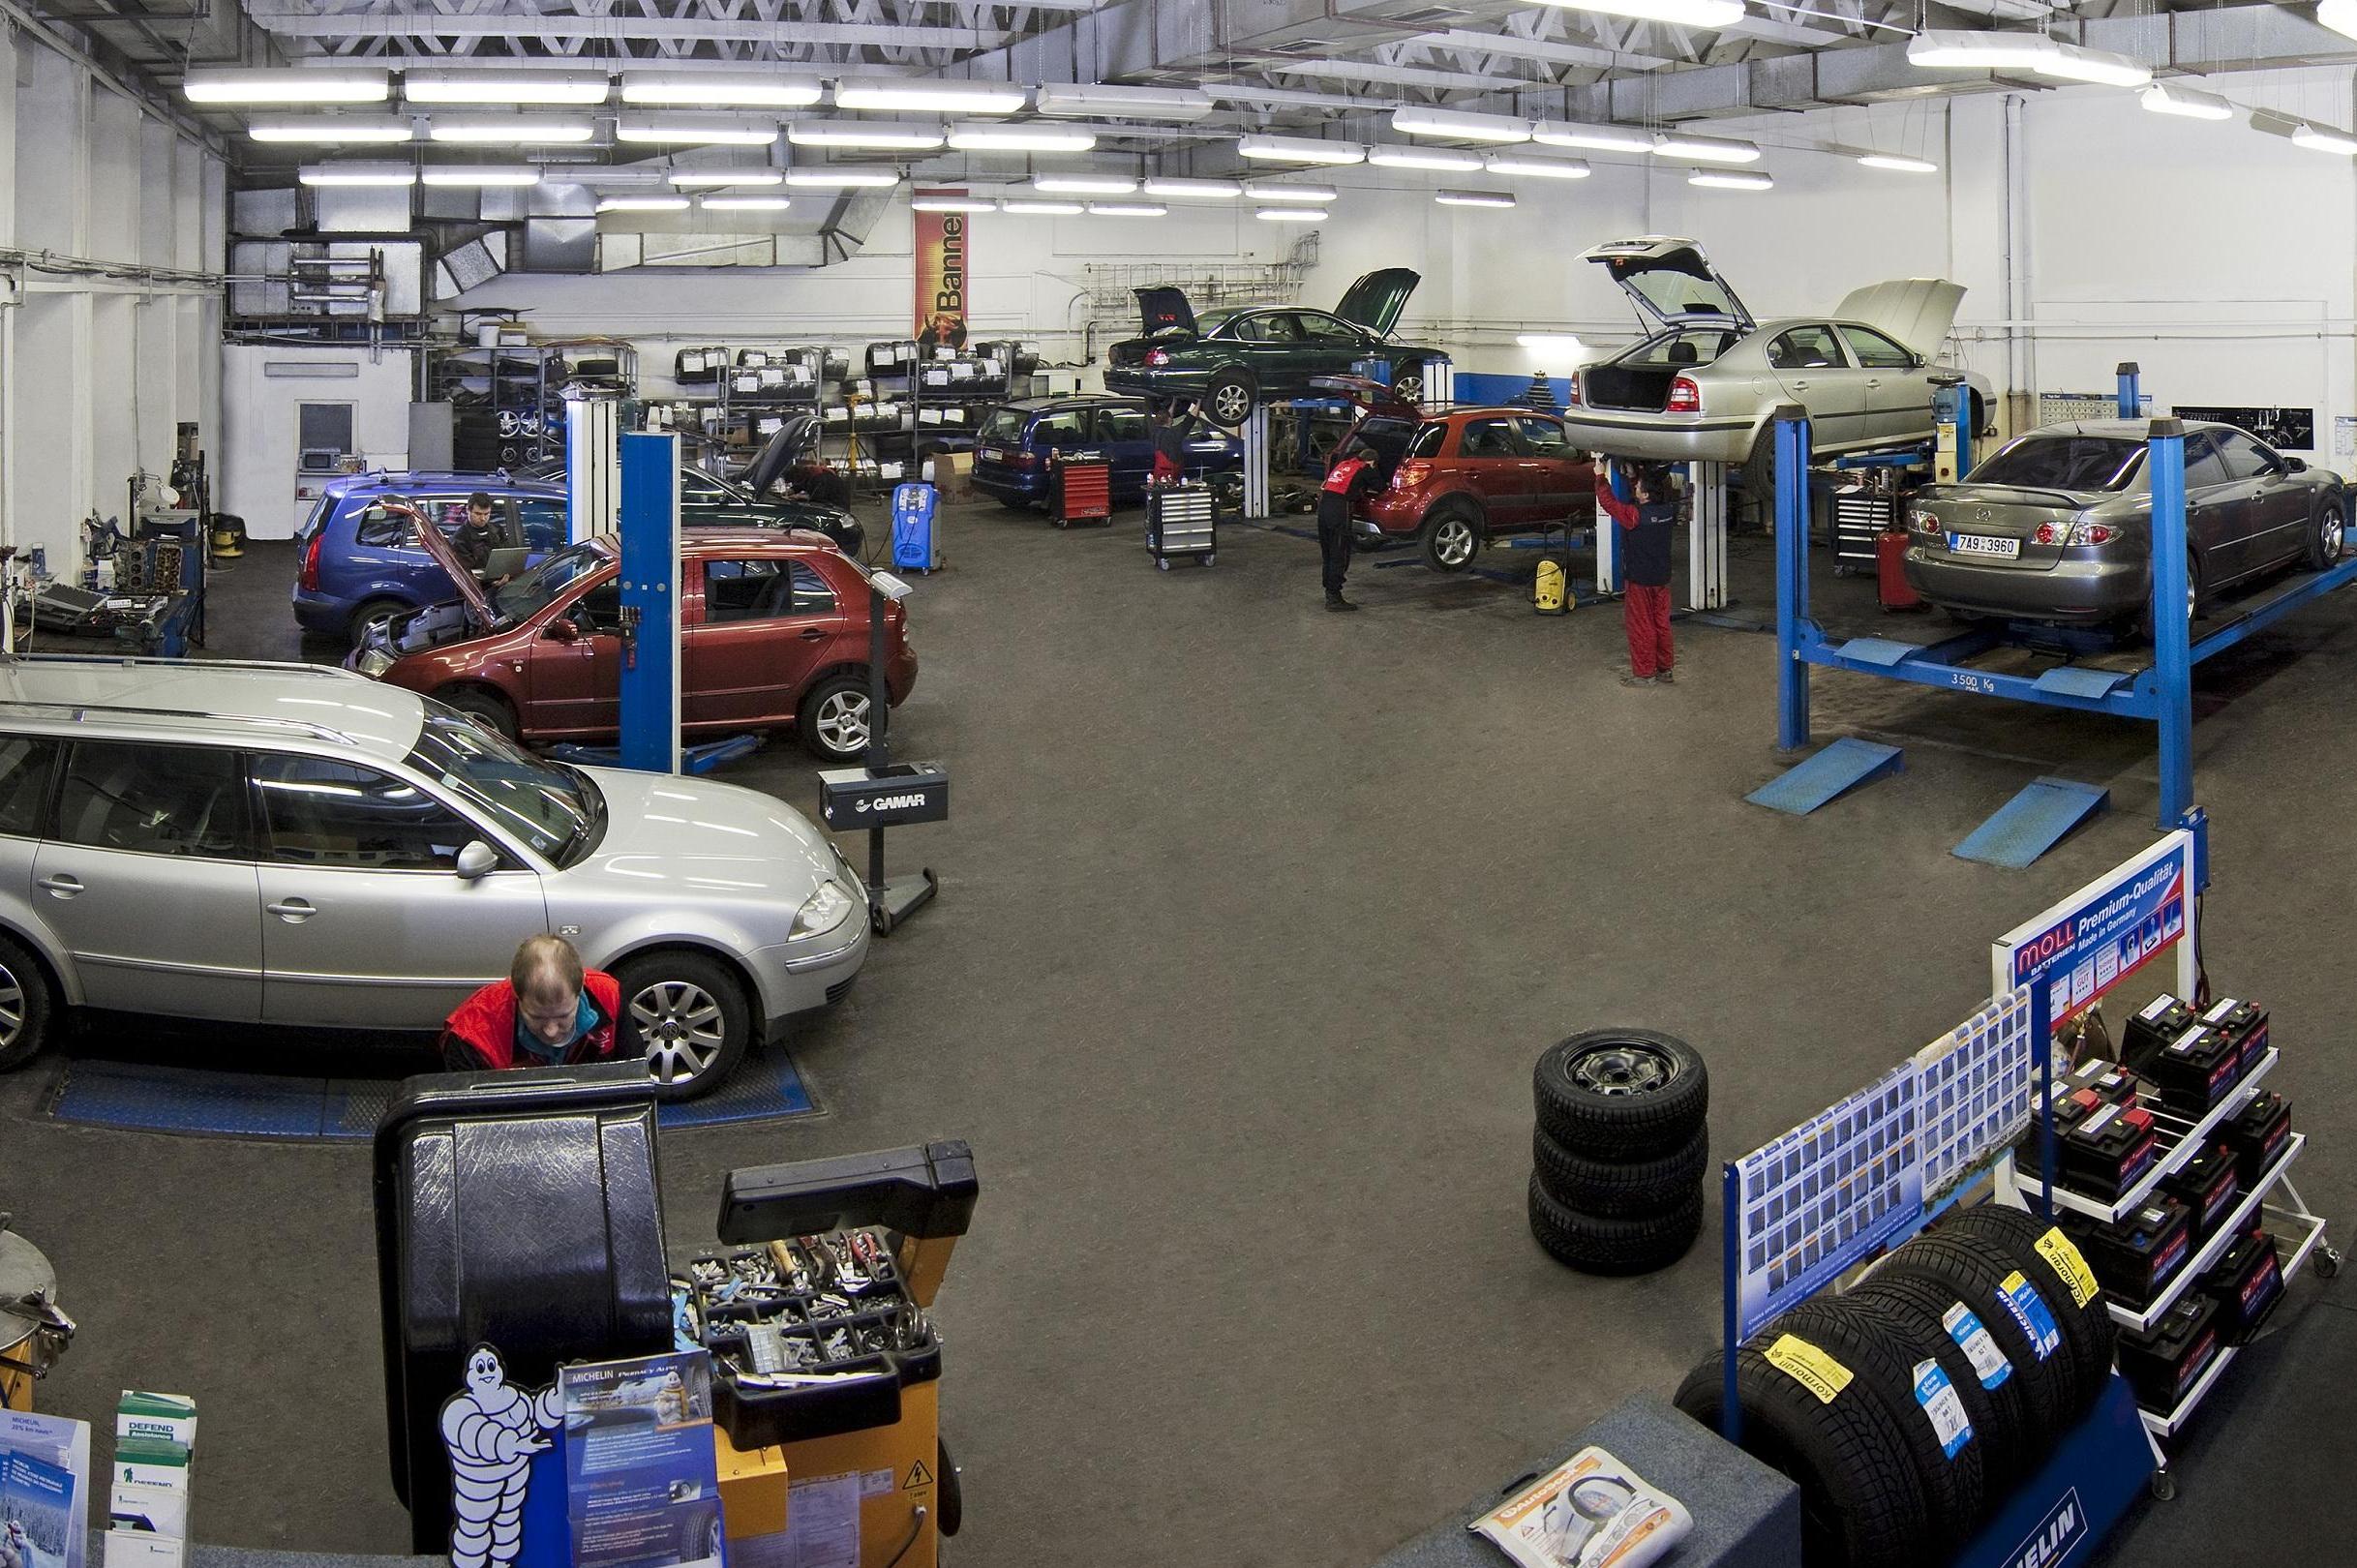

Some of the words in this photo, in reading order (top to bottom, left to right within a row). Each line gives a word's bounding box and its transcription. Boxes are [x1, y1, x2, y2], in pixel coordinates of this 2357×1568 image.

[1960, 536, 1979, 550] 7A9
[1987, 539, 2014, 553] 3960
[1951, 674, 1978, 686] 3500
[1983, 678, 1994, 692] Kg
[872, 794, 925, 811] GAMAR
[2078, 861, 2174, 937] Premium-Qualität
[2078, 930, 2098, 952] Made
[2099, 924, 2106, 938] in
[2107, 906, 2137, 930] Germany
[2031, 944, 2076, 977] BATTERIEN
[2076, 972, 2090, 987] GUT
[1996, 1290, 2037, 1342] MICHELIN
[572, 1370, 614, 1384] MICHELIN
[129, 1422, 174, 1432] DEFEND
[132, 1431, 172, 1440] Assistance
[2016, 1502, 2075, 1568] ELIN
